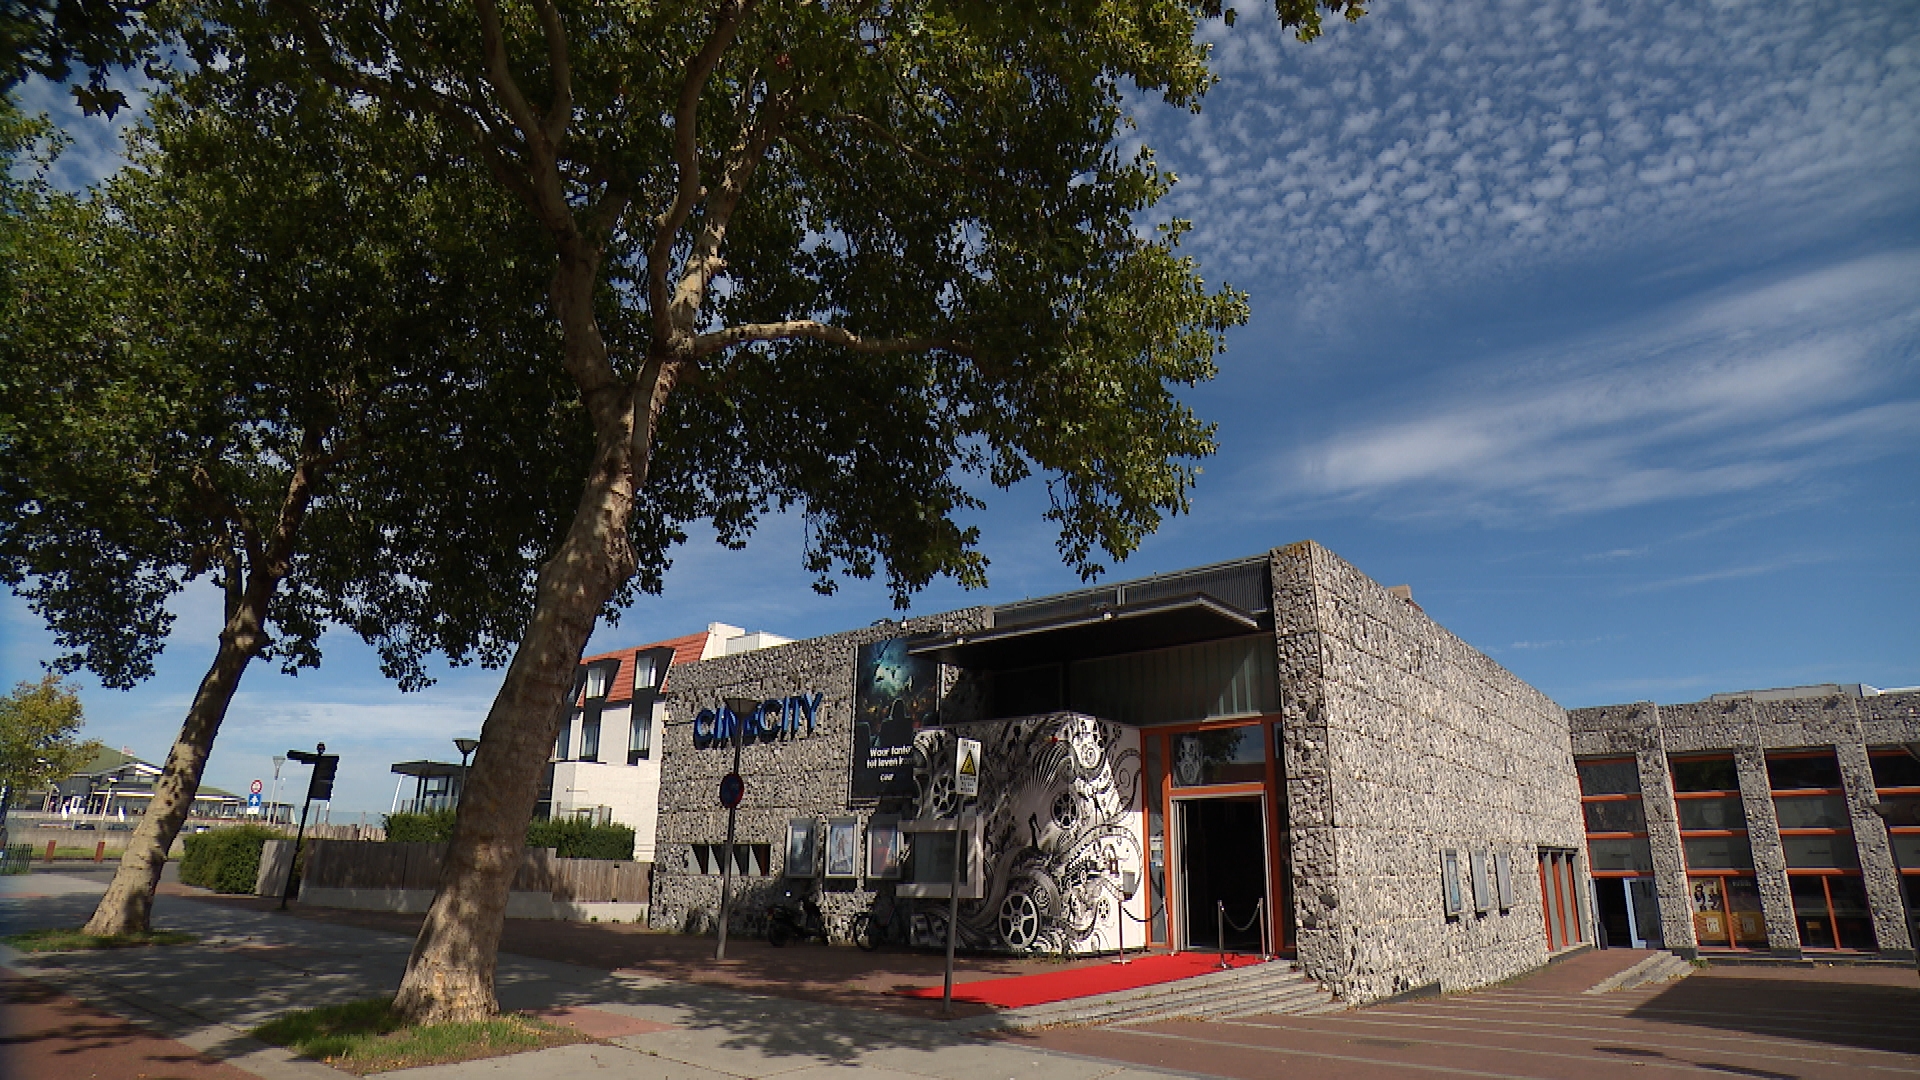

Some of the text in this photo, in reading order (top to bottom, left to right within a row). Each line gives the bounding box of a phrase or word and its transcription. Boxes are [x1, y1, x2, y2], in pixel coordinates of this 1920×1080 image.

[870, 748, 890, 757] Waar
[867, 758, 877, 768] tot
[878, 757, 898, 767] leven
